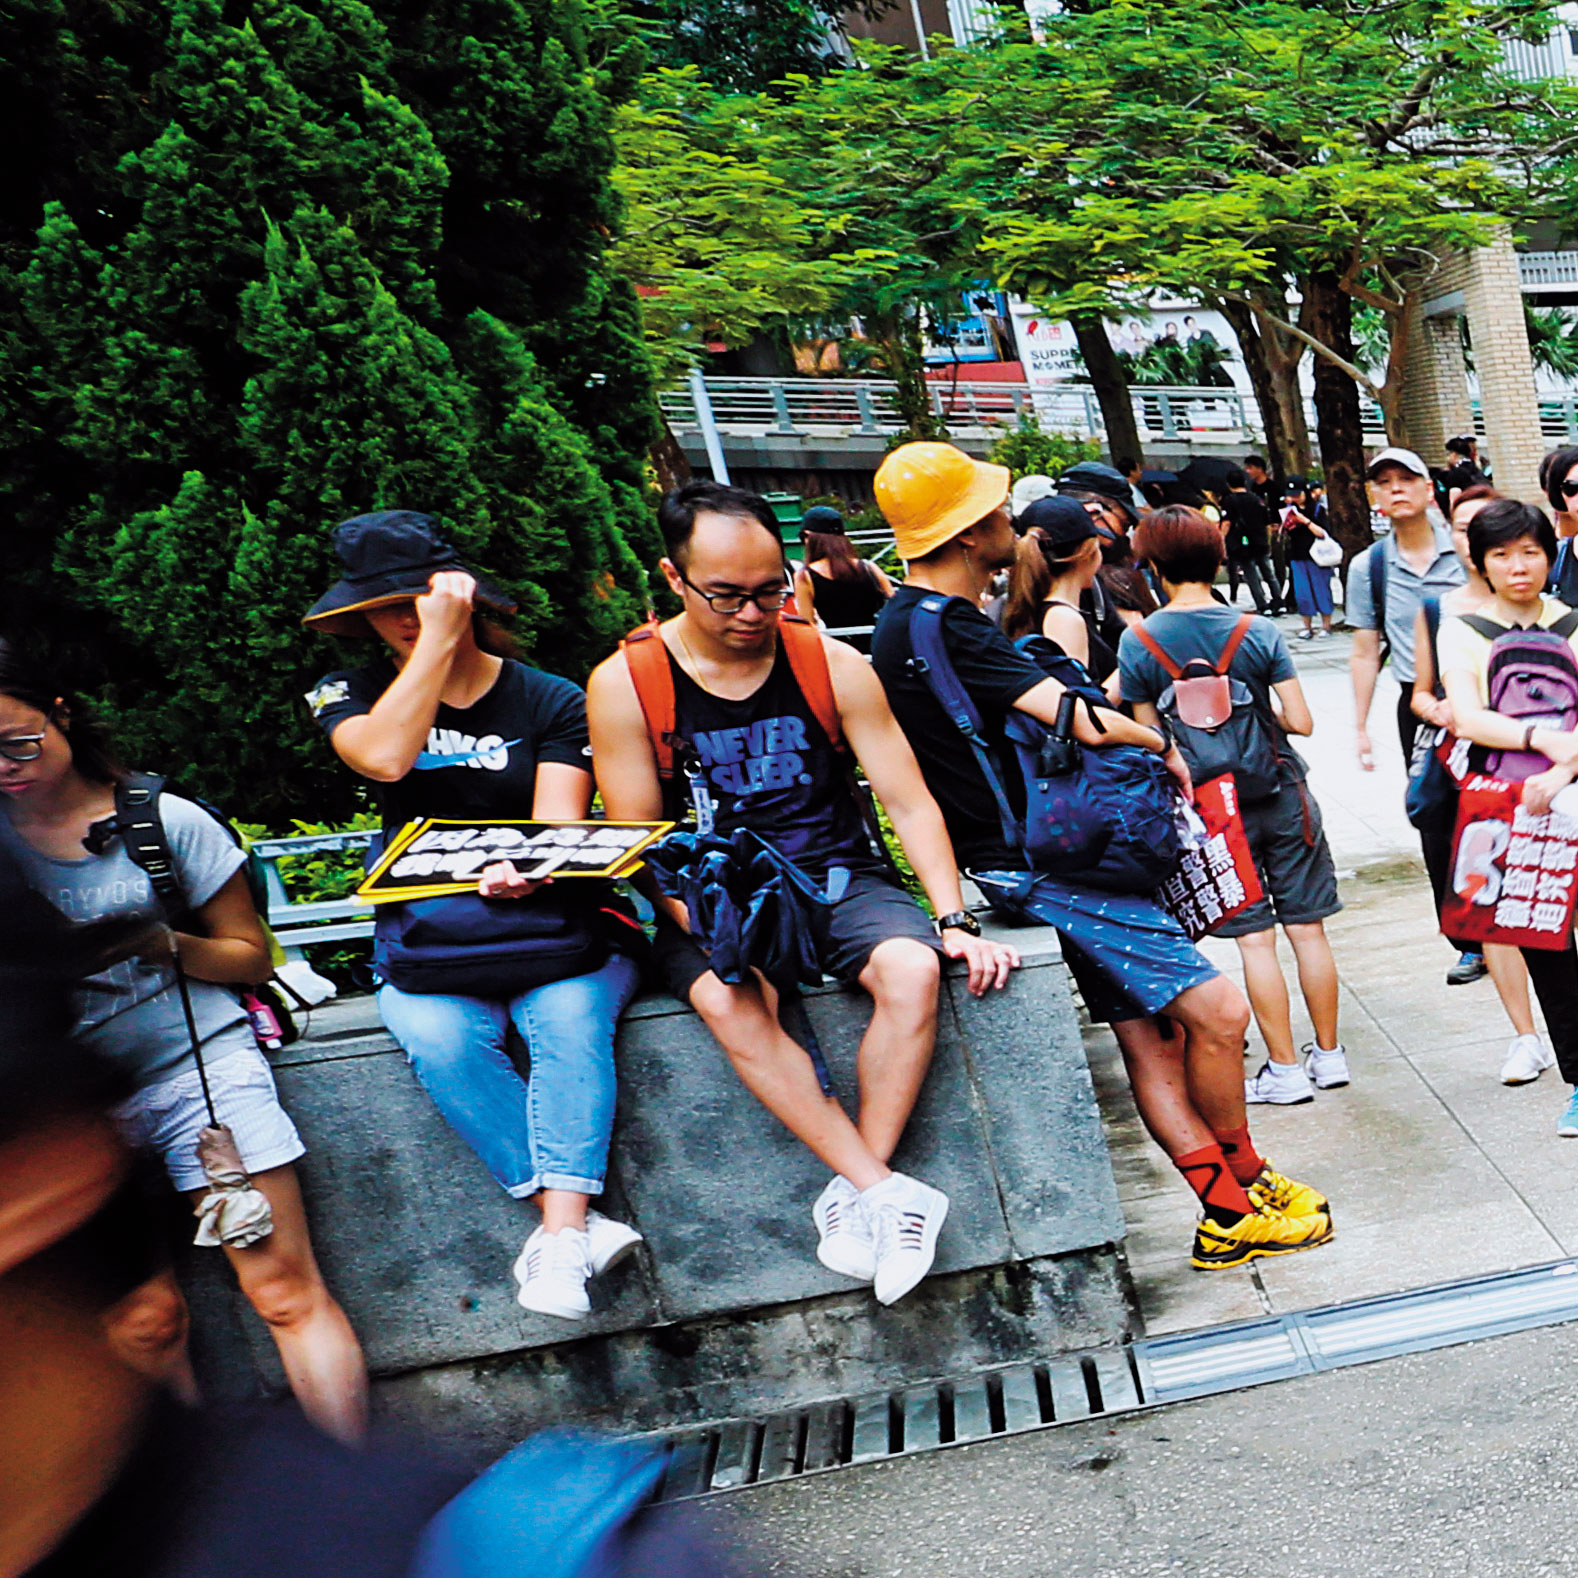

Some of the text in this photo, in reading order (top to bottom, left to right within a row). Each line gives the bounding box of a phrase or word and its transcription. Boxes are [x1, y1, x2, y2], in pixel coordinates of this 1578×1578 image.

[427, 726, 510, 772] HKG
[692, 715, 811, 766] NEVER
[711, 752, 813, 796] SLEEP.
